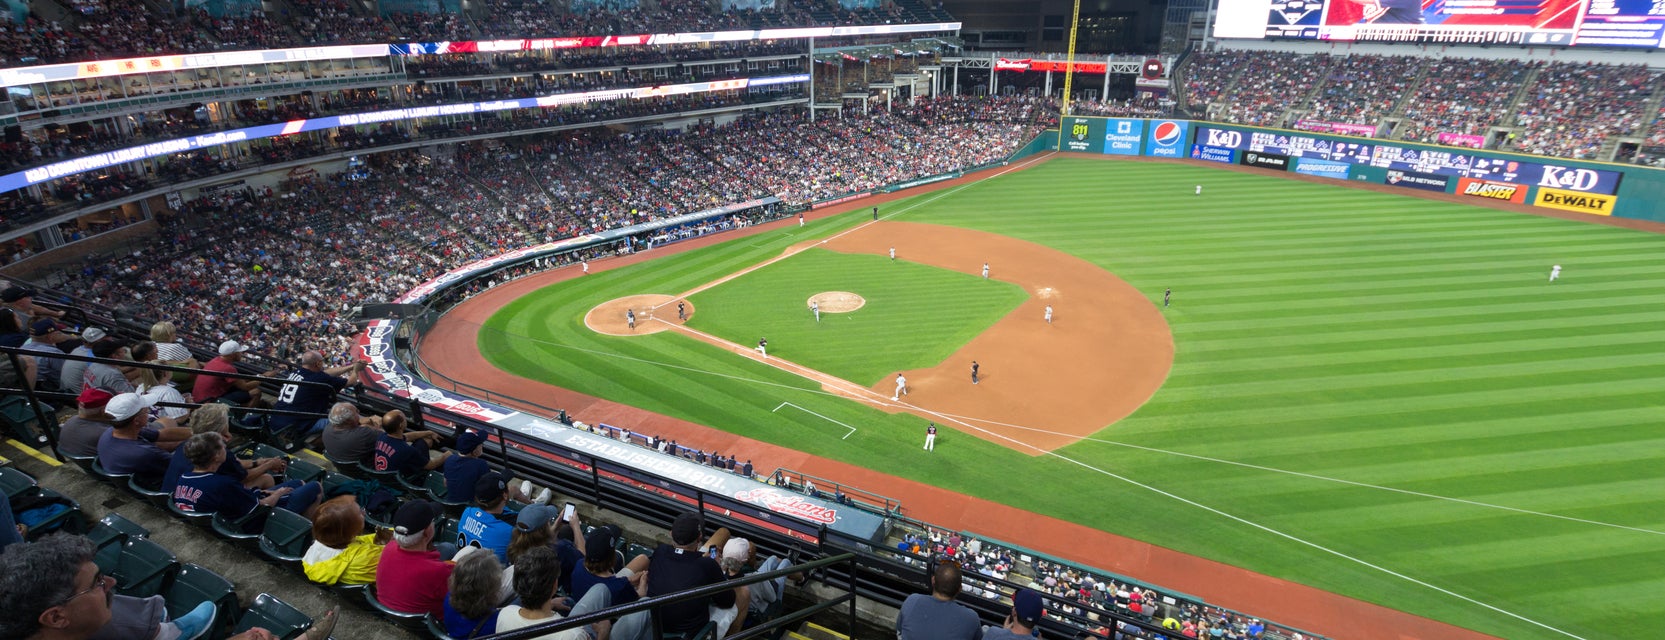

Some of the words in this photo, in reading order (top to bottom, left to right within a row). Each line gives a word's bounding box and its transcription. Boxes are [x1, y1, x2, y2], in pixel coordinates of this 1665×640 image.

[996, 60, 1028, 70] Budweiser
[360, 108, 408, 123] DOWNTOWN
[408, 106, 440, 118] LUXURY
[440, 104, 474, 116] HOUSING
[1072, 124, 1088, 136] 811
[1106, 134, 1140, 142] Cleveland
[1206, 128, 1242, 148] K&D
[50, 155, 108, 178] DOWNTOWN
[109, 144, 145, 164] LUXURY
[148, 138, 190, 154] HOUSING
[197, 131, 246, 148] KandD.com
[1203, 146, 1230, 155] SHERWIN
[1200, 153, 1230, 162] WILLIAMS
[1258, 157, 1284, 165] RAM
[1296, 164, 1350, 173] PROGRESSIVE
[1416, 178, 1446, 186] NETWORK
[1538, 164, 1598, 191] K&D
[1464, 182, 1516, 200] BLASTER
[1544, 193, 1607, 210] DEWALT
[418, 392, 442, 402] 2013
[456, 404, 478, 413] 2016
[566, 435, 680, 474] ESTABLISHED
[680, 467, 726, 488] 1901.
[735, 488, 836, 524] Indians
[462, 516, 488, 538] JUDGE
